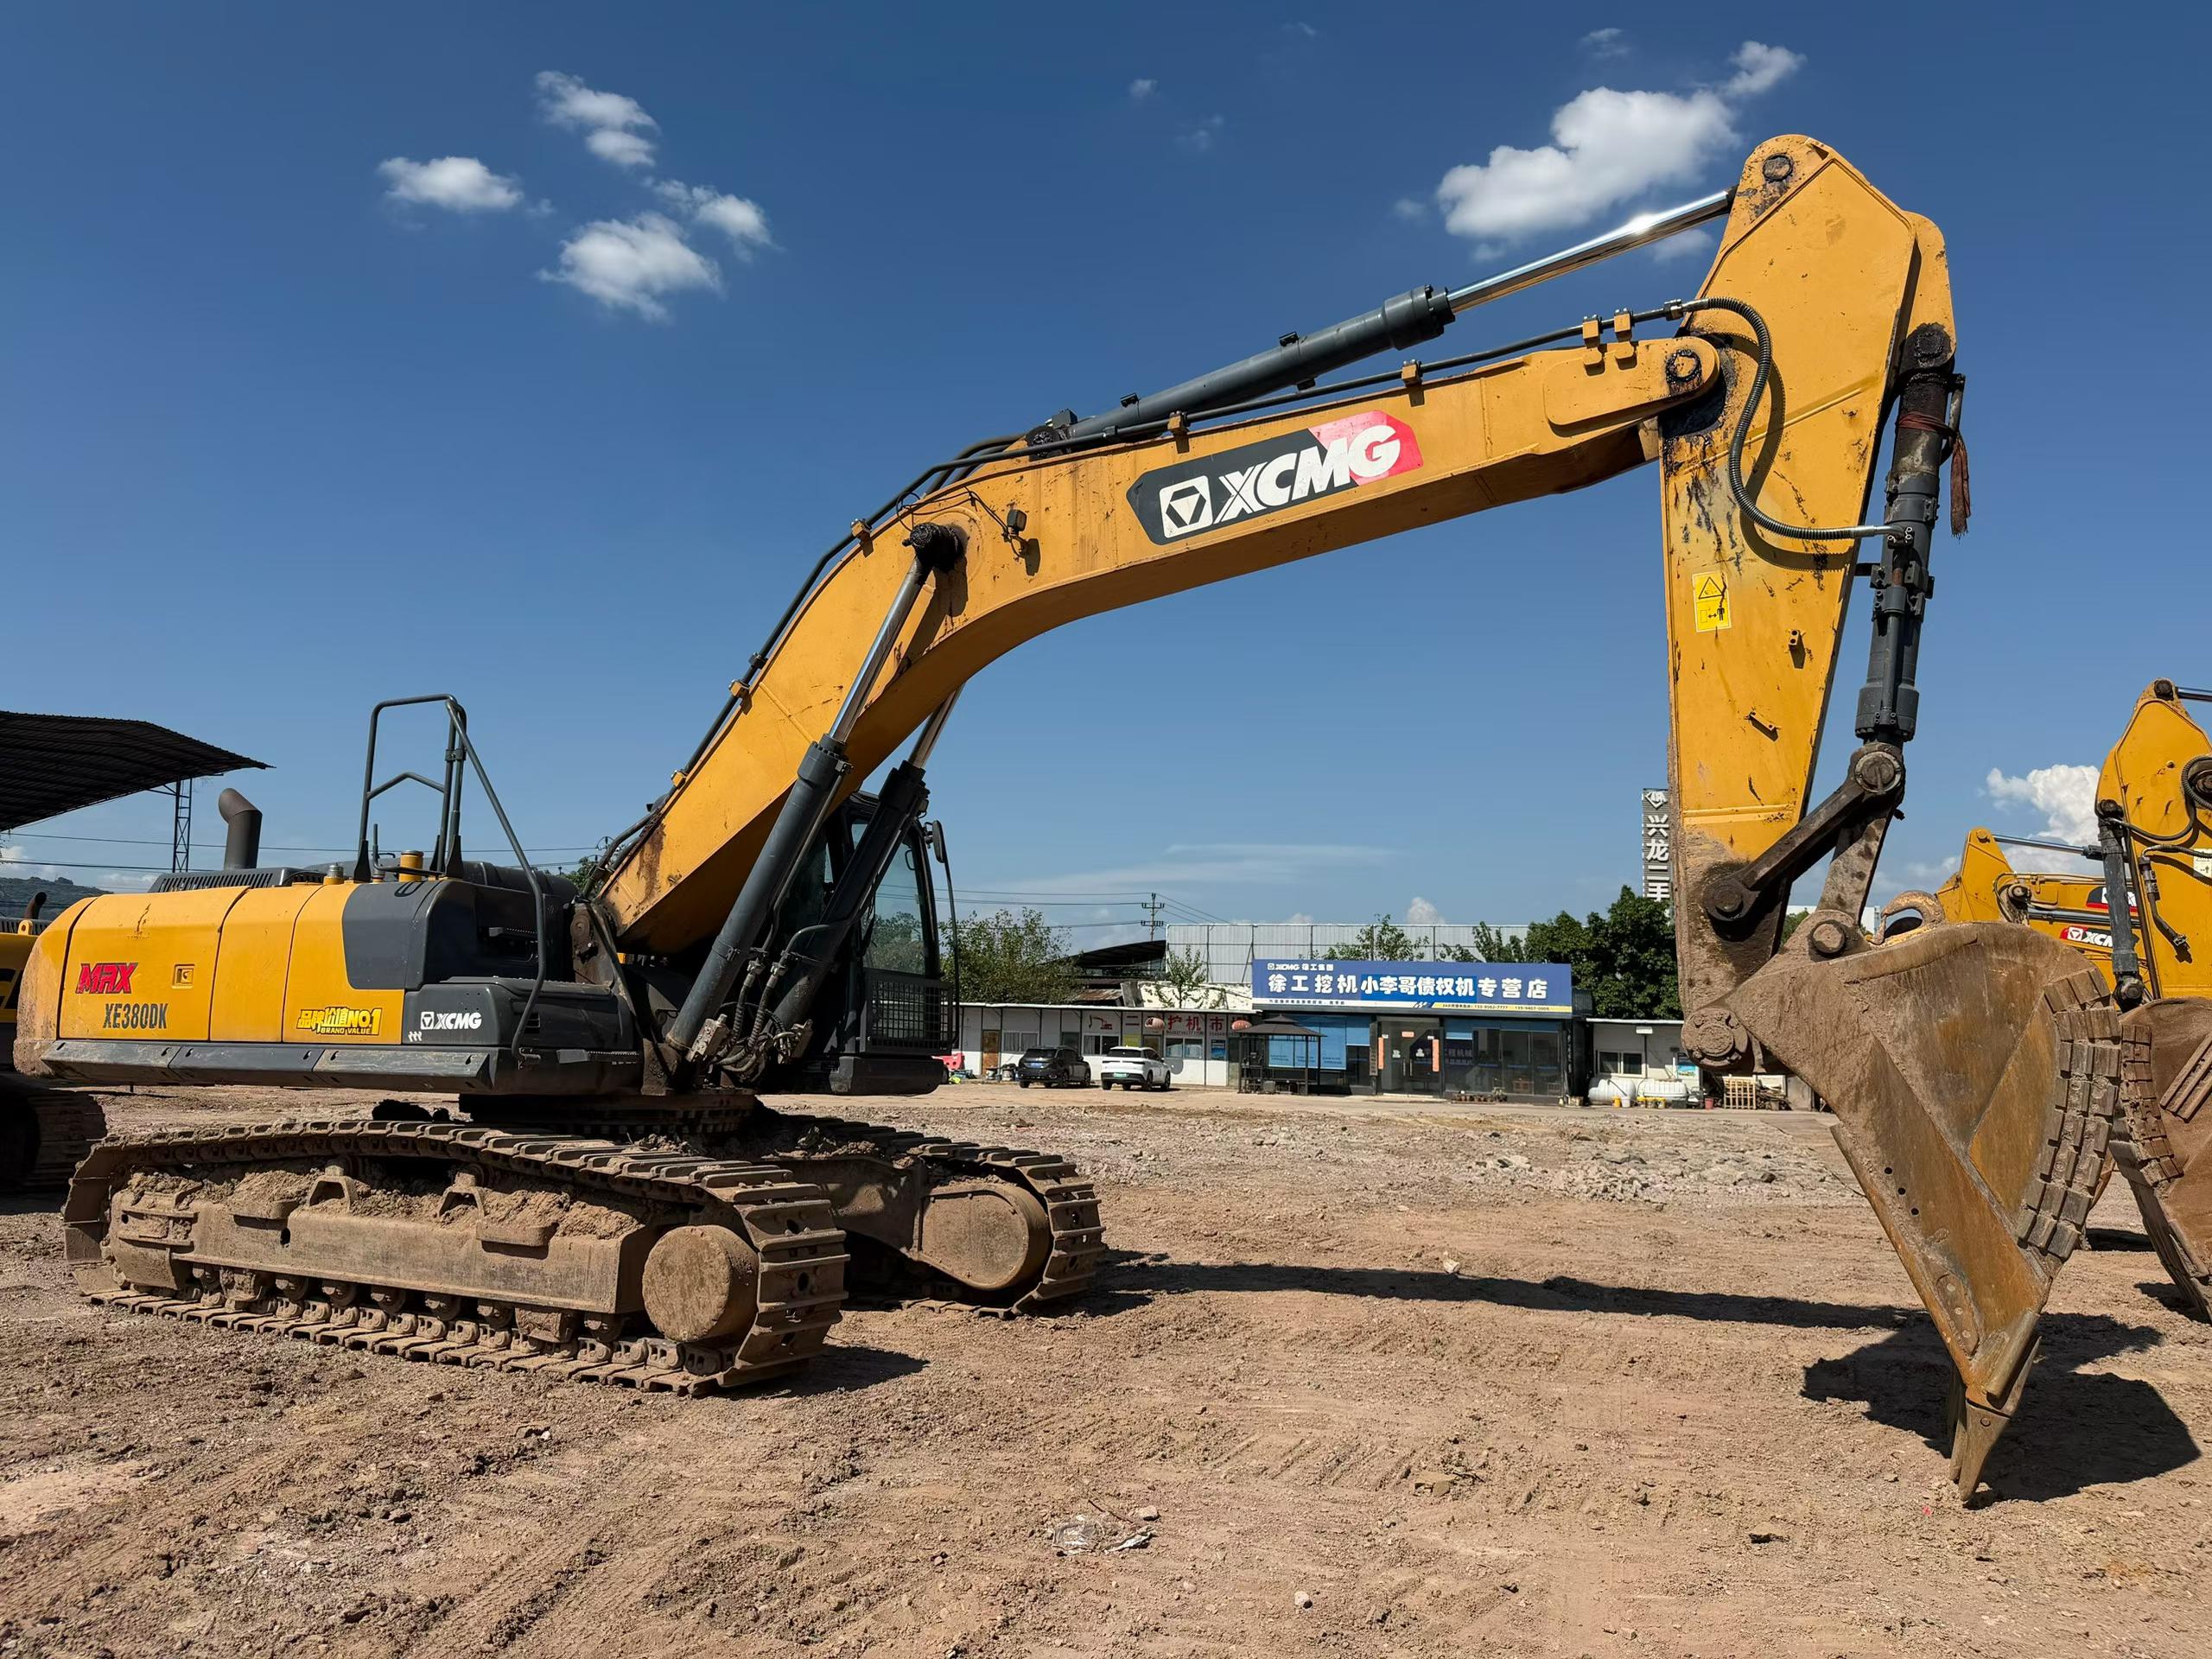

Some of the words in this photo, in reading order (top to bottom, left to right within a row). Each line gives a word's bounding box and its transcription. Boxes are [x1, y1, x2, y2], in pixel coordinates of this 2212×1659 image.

[1213, 425, 1401, 524] XCMG
[75, 963, 138, 994] MAX
[103, 1003, 168, 1029] XE380DK
[434, 1012, 482, 1029] XCMG
